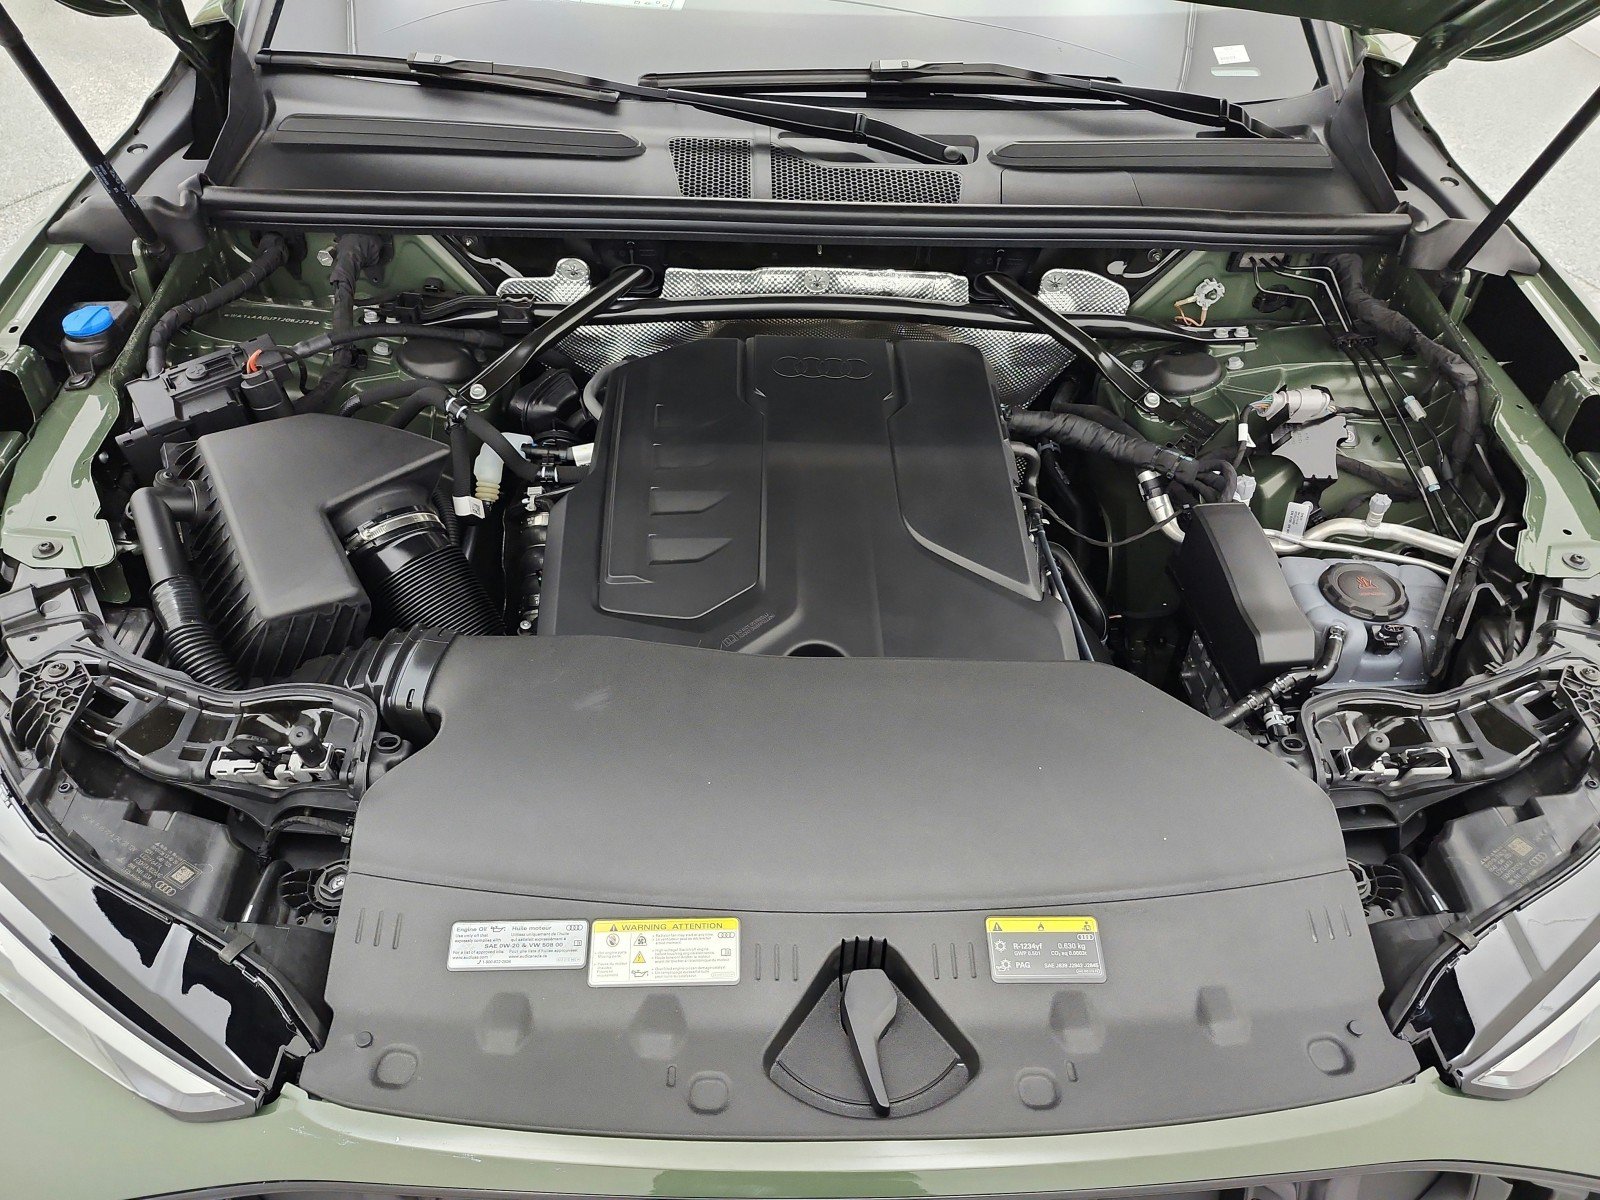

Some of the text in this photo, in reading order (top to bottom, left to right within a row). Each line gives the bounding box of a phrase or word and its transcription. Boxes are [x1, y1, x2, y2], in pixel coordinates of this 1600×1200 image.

[672, 922, 723, 930] ATTENTION
[1012, 942, 1086, 951] R-1234yf 0.630 kg
[1015, 961, 1031, 969] PAG
